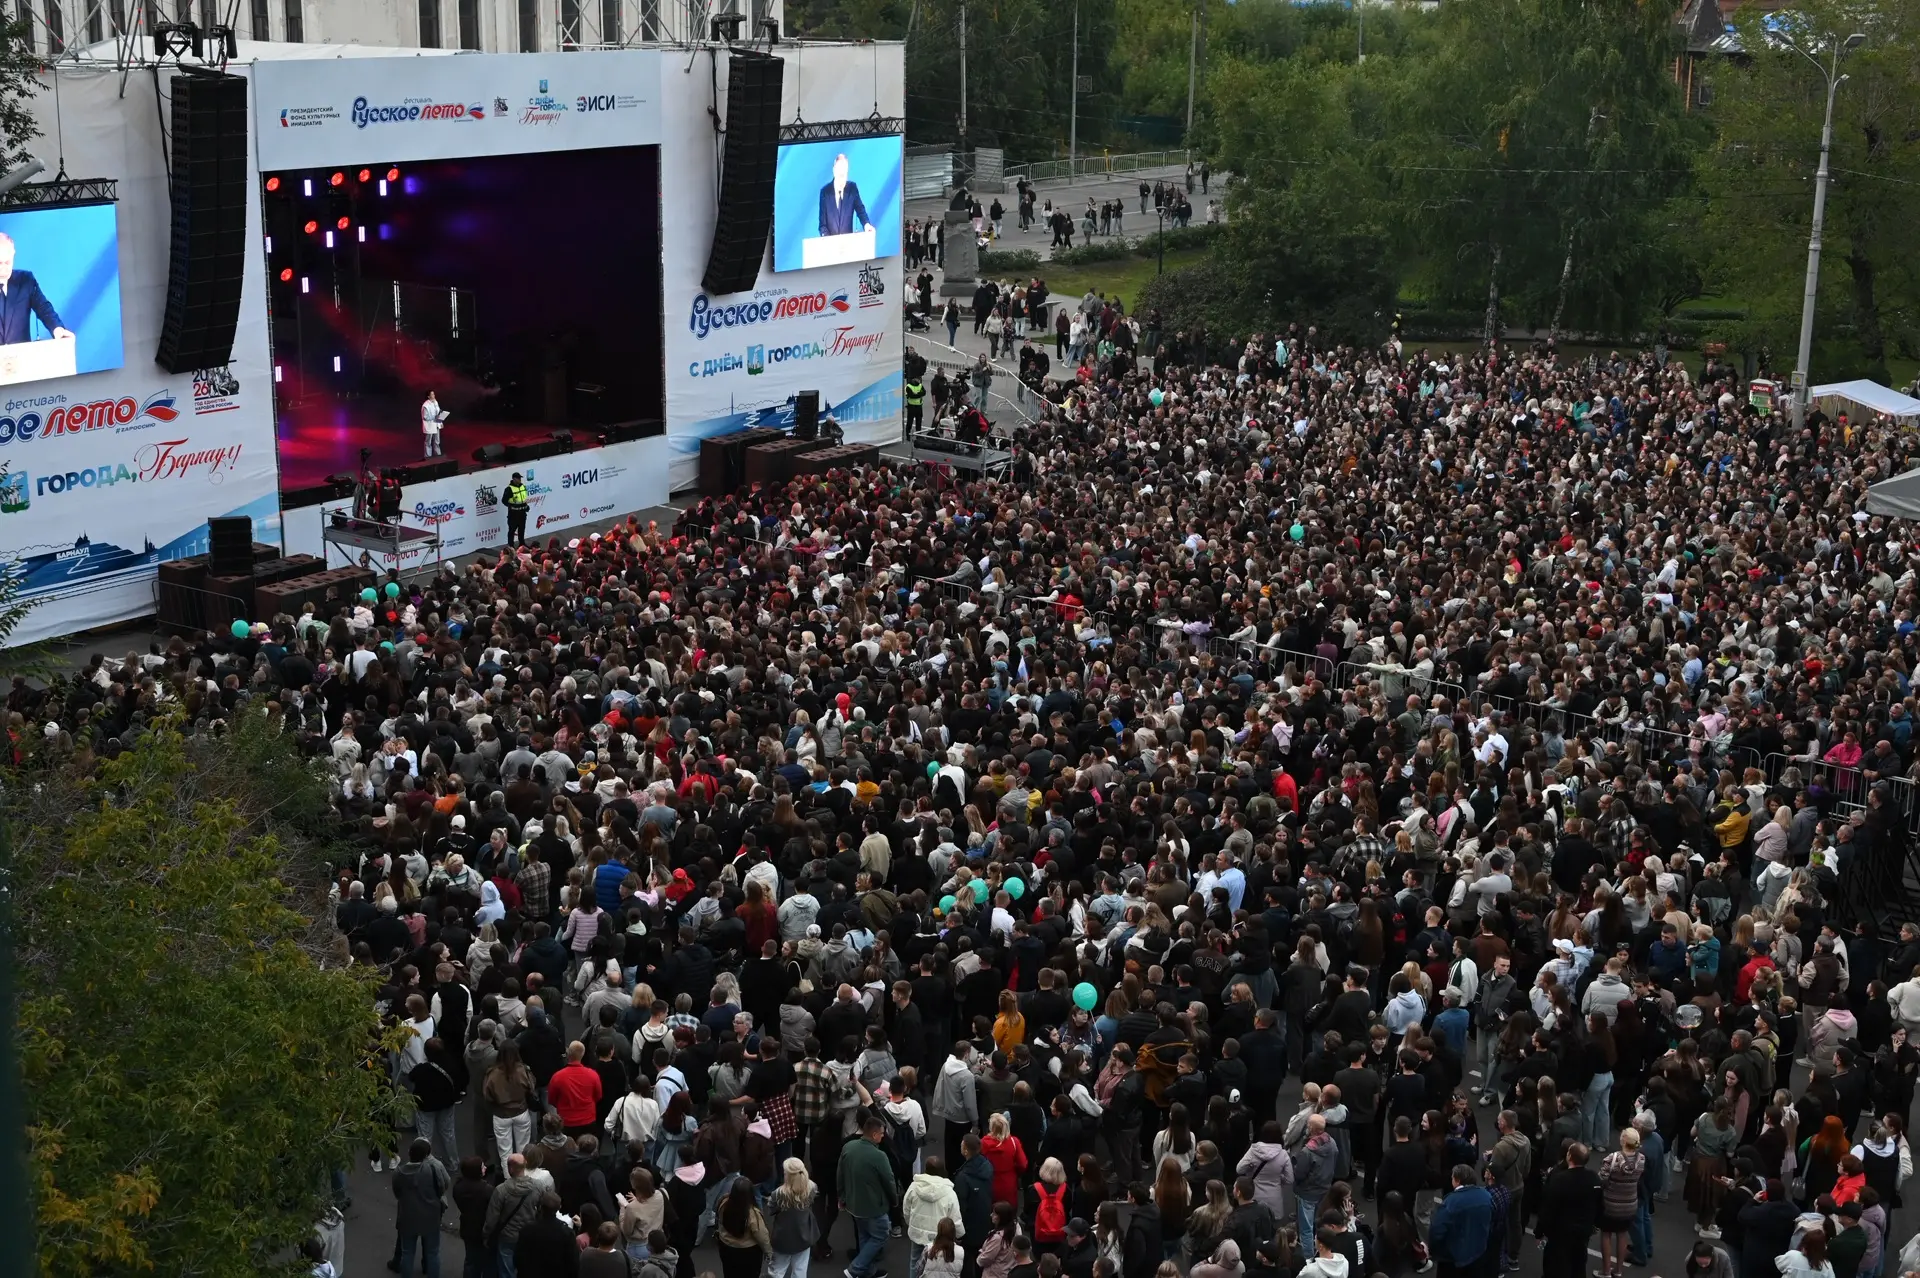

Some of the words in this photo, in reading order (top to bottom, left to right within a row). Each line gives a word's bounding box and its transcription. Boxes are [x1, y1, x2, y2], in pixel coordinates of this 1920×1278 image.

[403, 97, 433, 105] фестиваль
[535, 95, 554, 106] ДНЁМ
[576, 95, 615, 112] ЭИСИ
[290, 106, 334, 114] ПРЕЗИДЕНТСКИЙ
[351, 96, 420, 129] Русское
[420, 103, 465, 120] лето
[753, 287, 789, 300] фестиваль
[688, 293, 773, 340] Русское
[771, 291, 827, 320] лето
[823, 325, 885, 359] Барнаул!
[689, 361, 700, 377] С
[702, 353, 743, 378] ДНЁМ
[768, 341, 825, 364] ГОРОДА,
[192, 368, 208, 382] 20
[193, 382, 208, 397] 26
[5, 394, 68, 414] фестиваль
[39, 396, 138, 439] лето
[134, 438, 242, 484] Барнаул!
[37, 463, 138, 496] ГОРОДА,
[562, 468, 598, 489] ЭИСИ
[546, 514, 570, 524] ЮНАРМИЯ
[56, 547, 90, 560] БАРНАУЛ
[383, 550, 418, 564] ГОРОСТЬ
